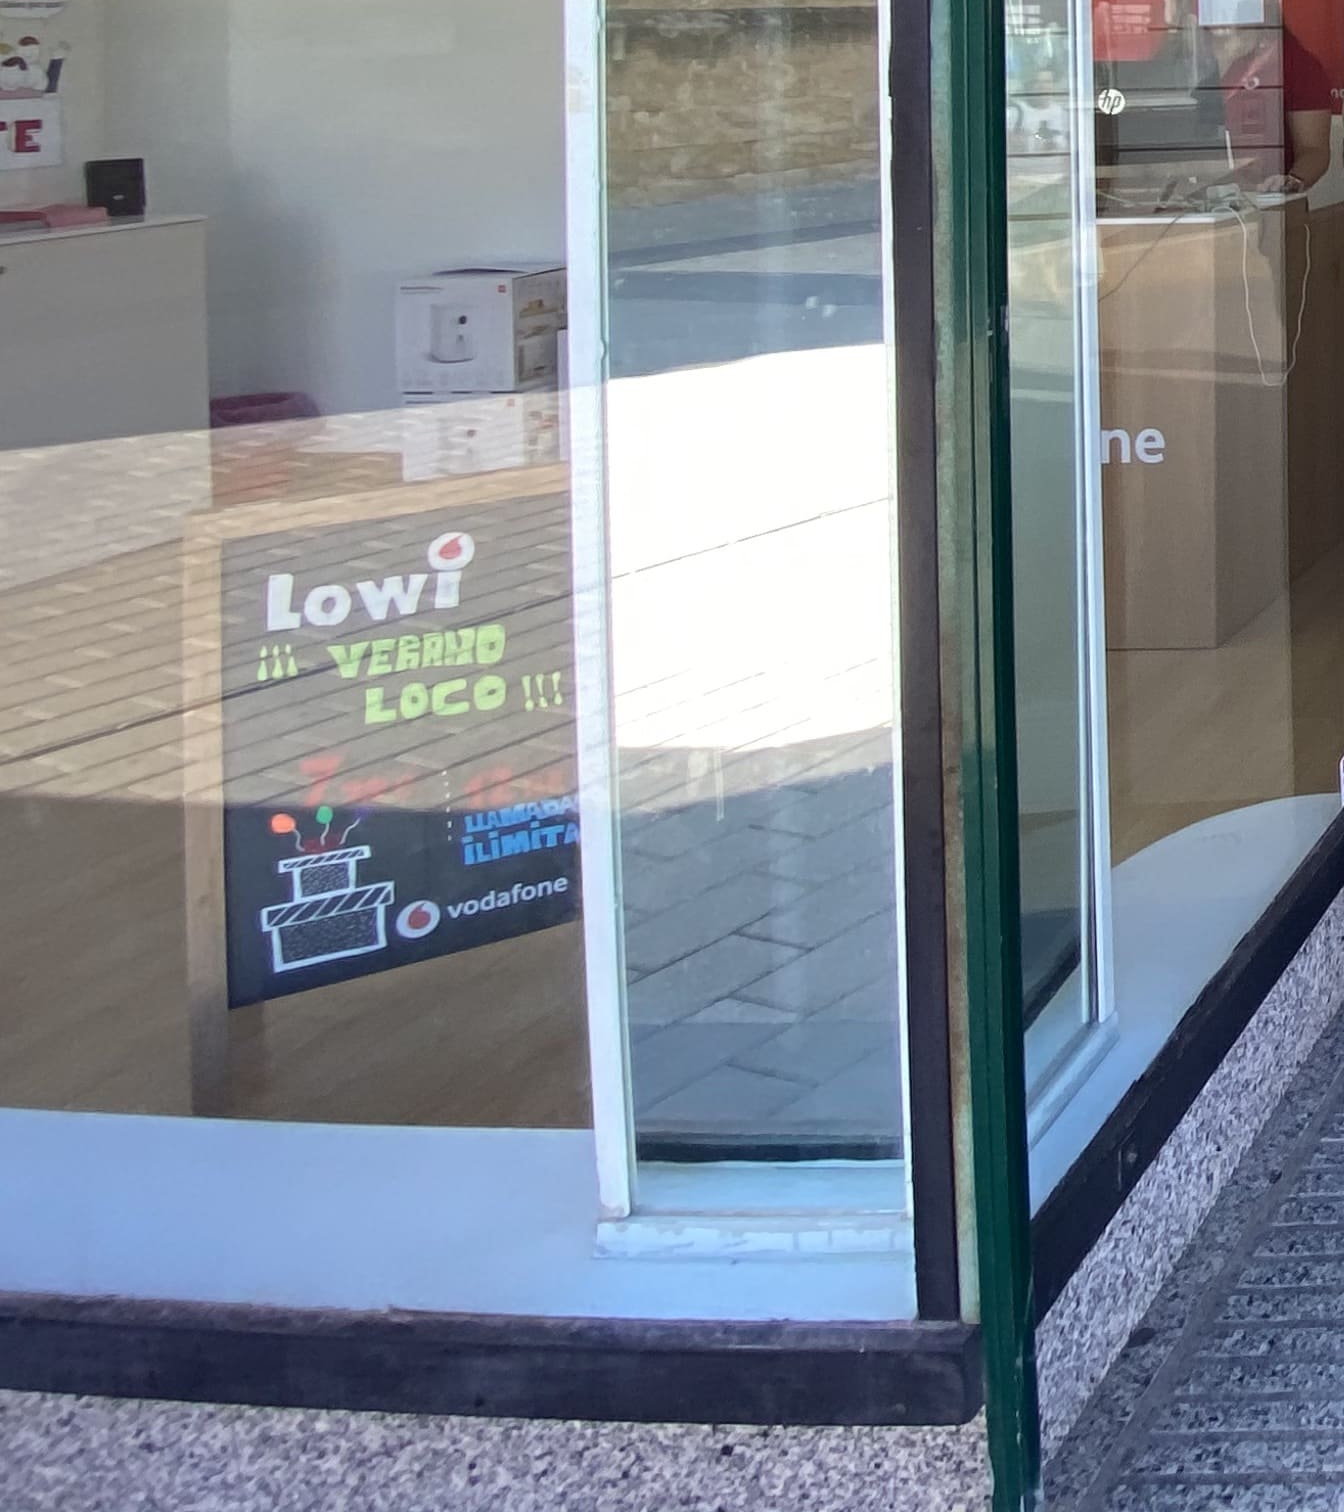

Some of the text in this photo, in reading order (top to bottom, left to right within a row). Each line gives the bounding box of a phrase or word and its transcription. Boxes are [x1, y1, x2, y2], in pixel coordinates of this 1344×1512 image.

[1101, 88, 1123, 115] hp
[326, 623, 506, 679] VERANO
[364, 675, 506, 724] LOCO
[464, 792, 579, 833] LLAMADA
[446, 876, 569, 920] vodafone
